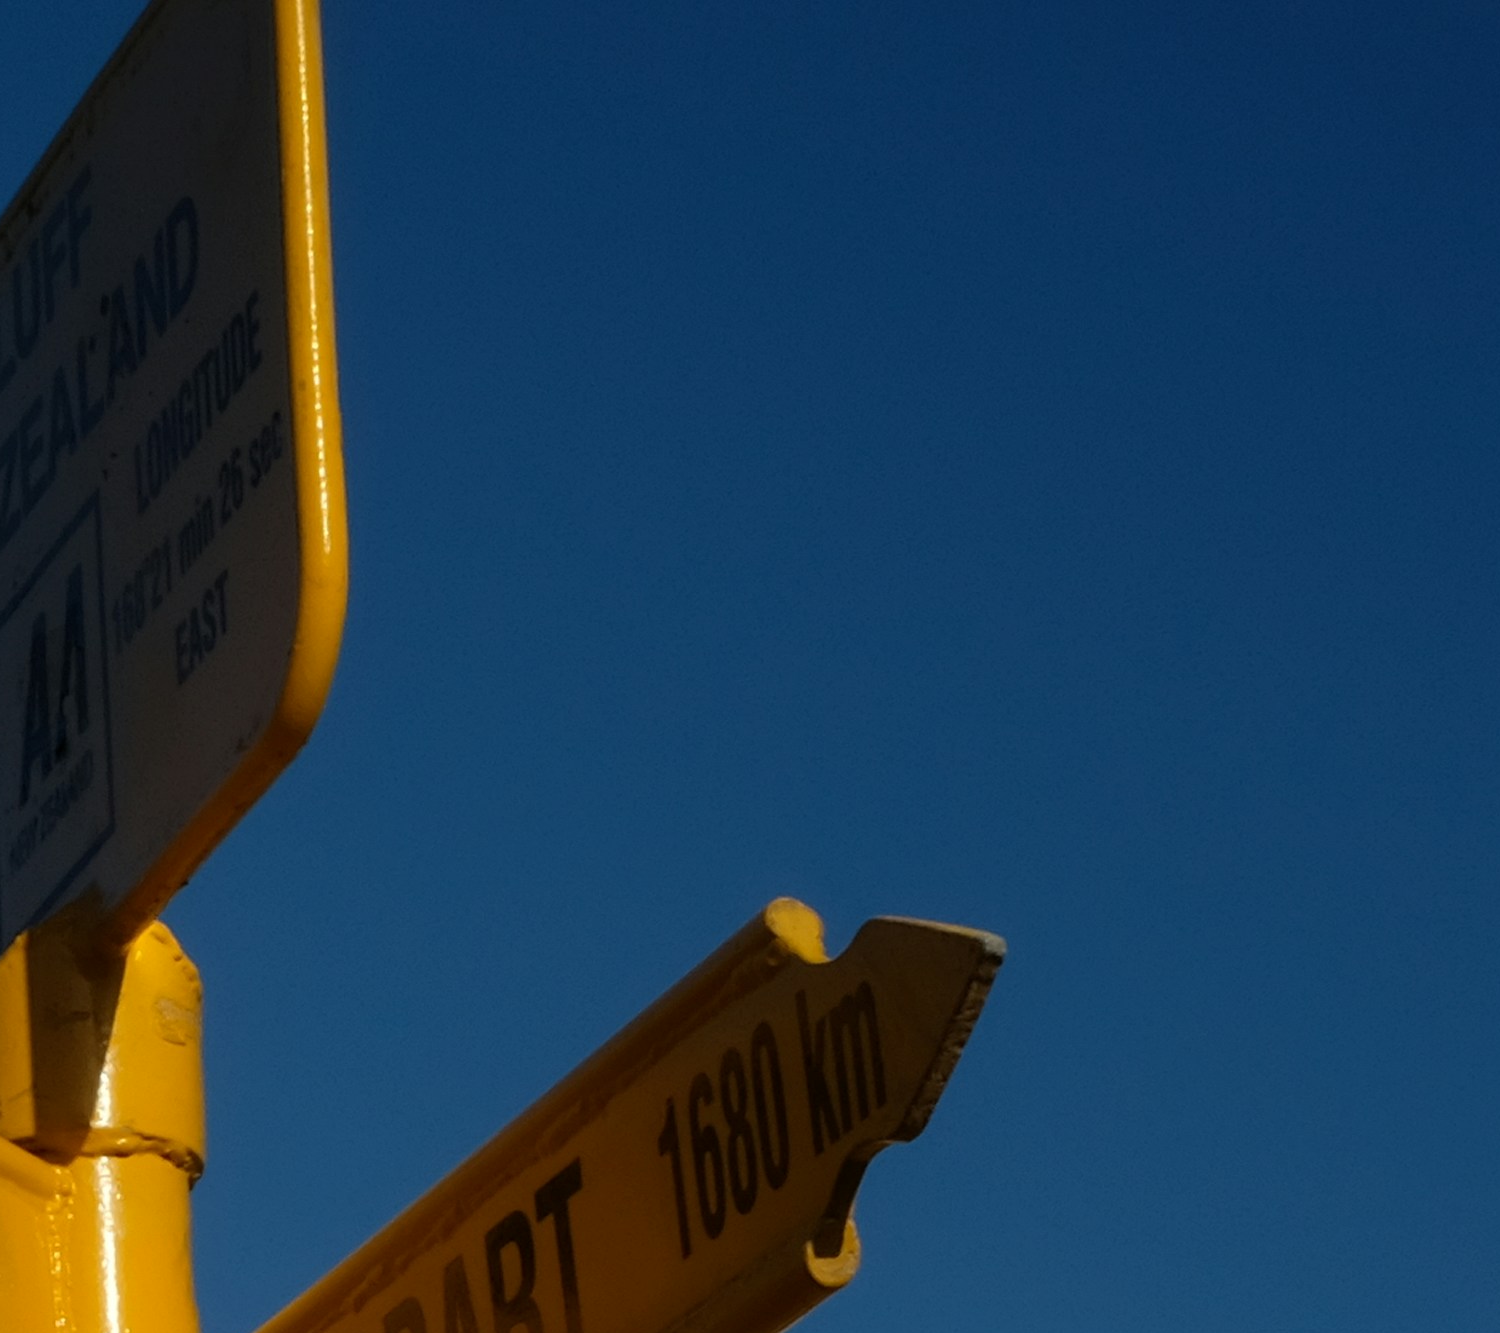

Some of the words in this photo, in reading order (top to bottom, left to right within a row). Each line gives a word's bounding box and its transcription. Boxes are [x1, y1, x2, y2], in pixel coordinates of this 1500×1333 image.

[134, 289, 263, 514] LONGITUDE
[178, 495, 215, 575] min
[219, 447, 244, 527] 26
[248, 410, 284, 488] sec
[19, 562, 90, 808] AA
[174, 568, 229, 685] EAST
[657, 1021, 791, 1260] 1680
[796, 979, 890, 1158] km
